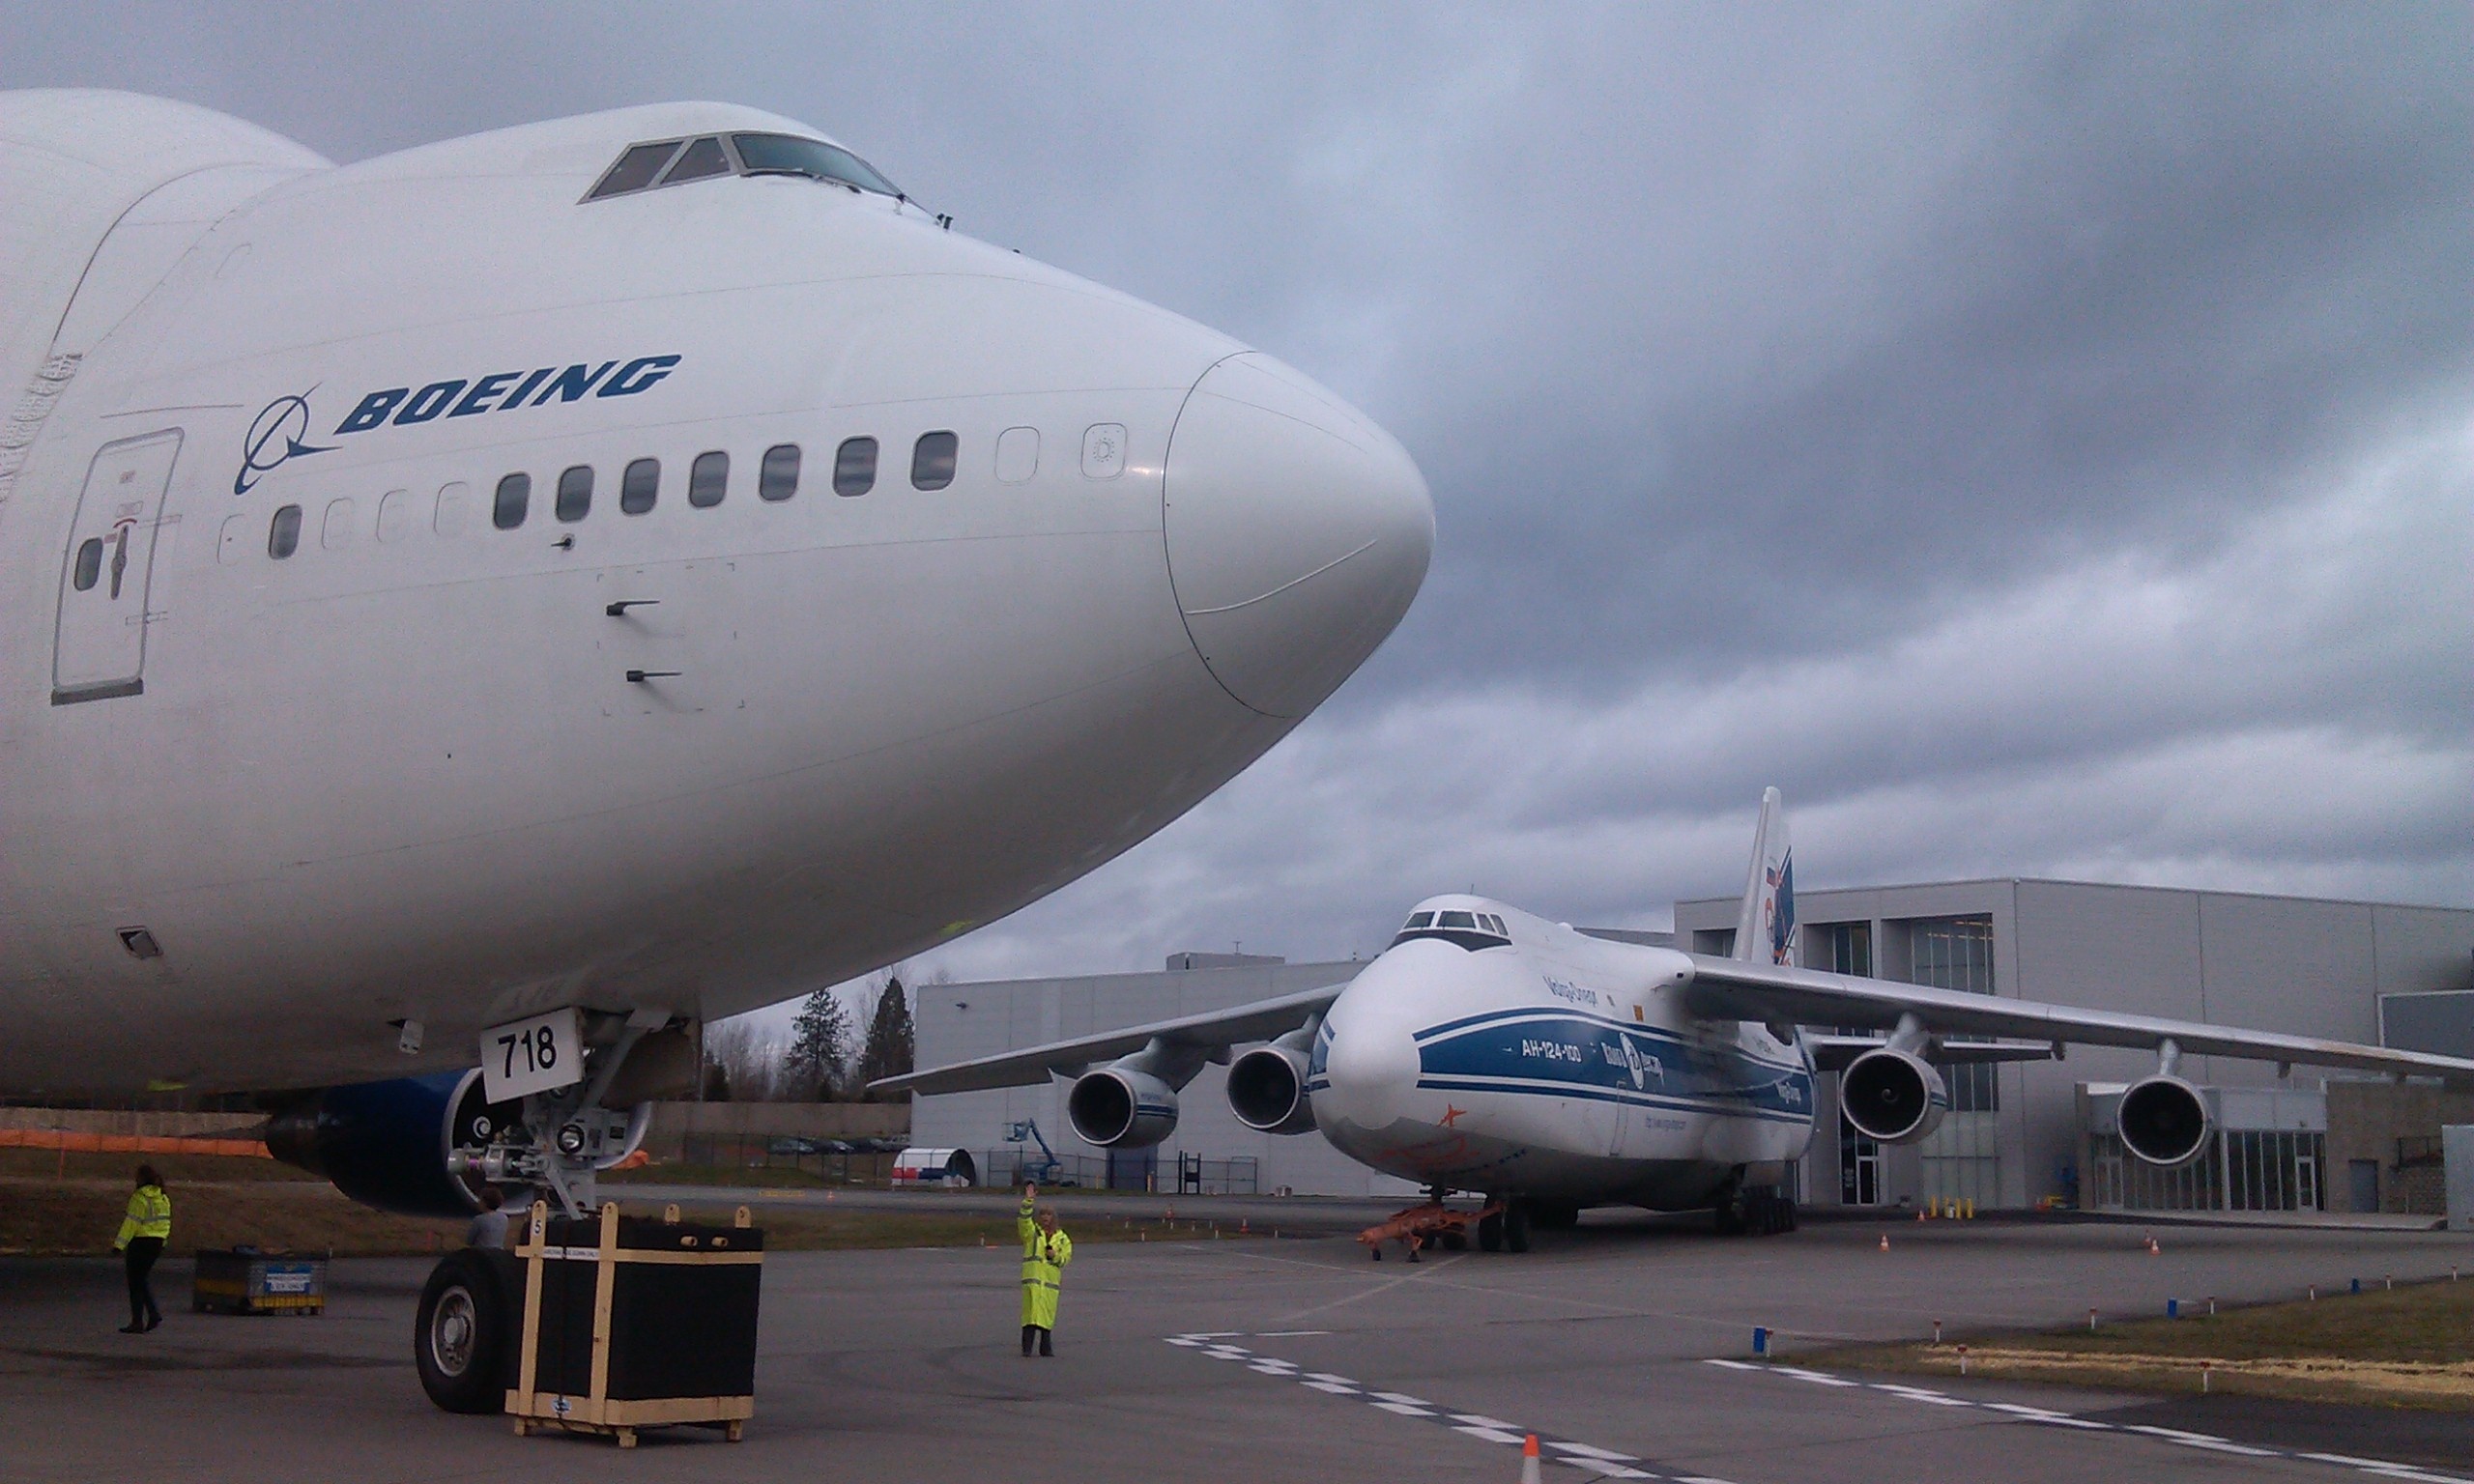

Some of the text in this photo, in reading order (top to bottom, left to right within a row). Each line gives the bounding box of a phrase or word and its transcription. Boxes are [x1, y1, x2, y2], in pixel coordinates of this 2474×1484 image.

[333, 355, 682, 435] BOEING
[498, 1025, 557, 1078] 718
[533, 1219, 542, 1235] 5
